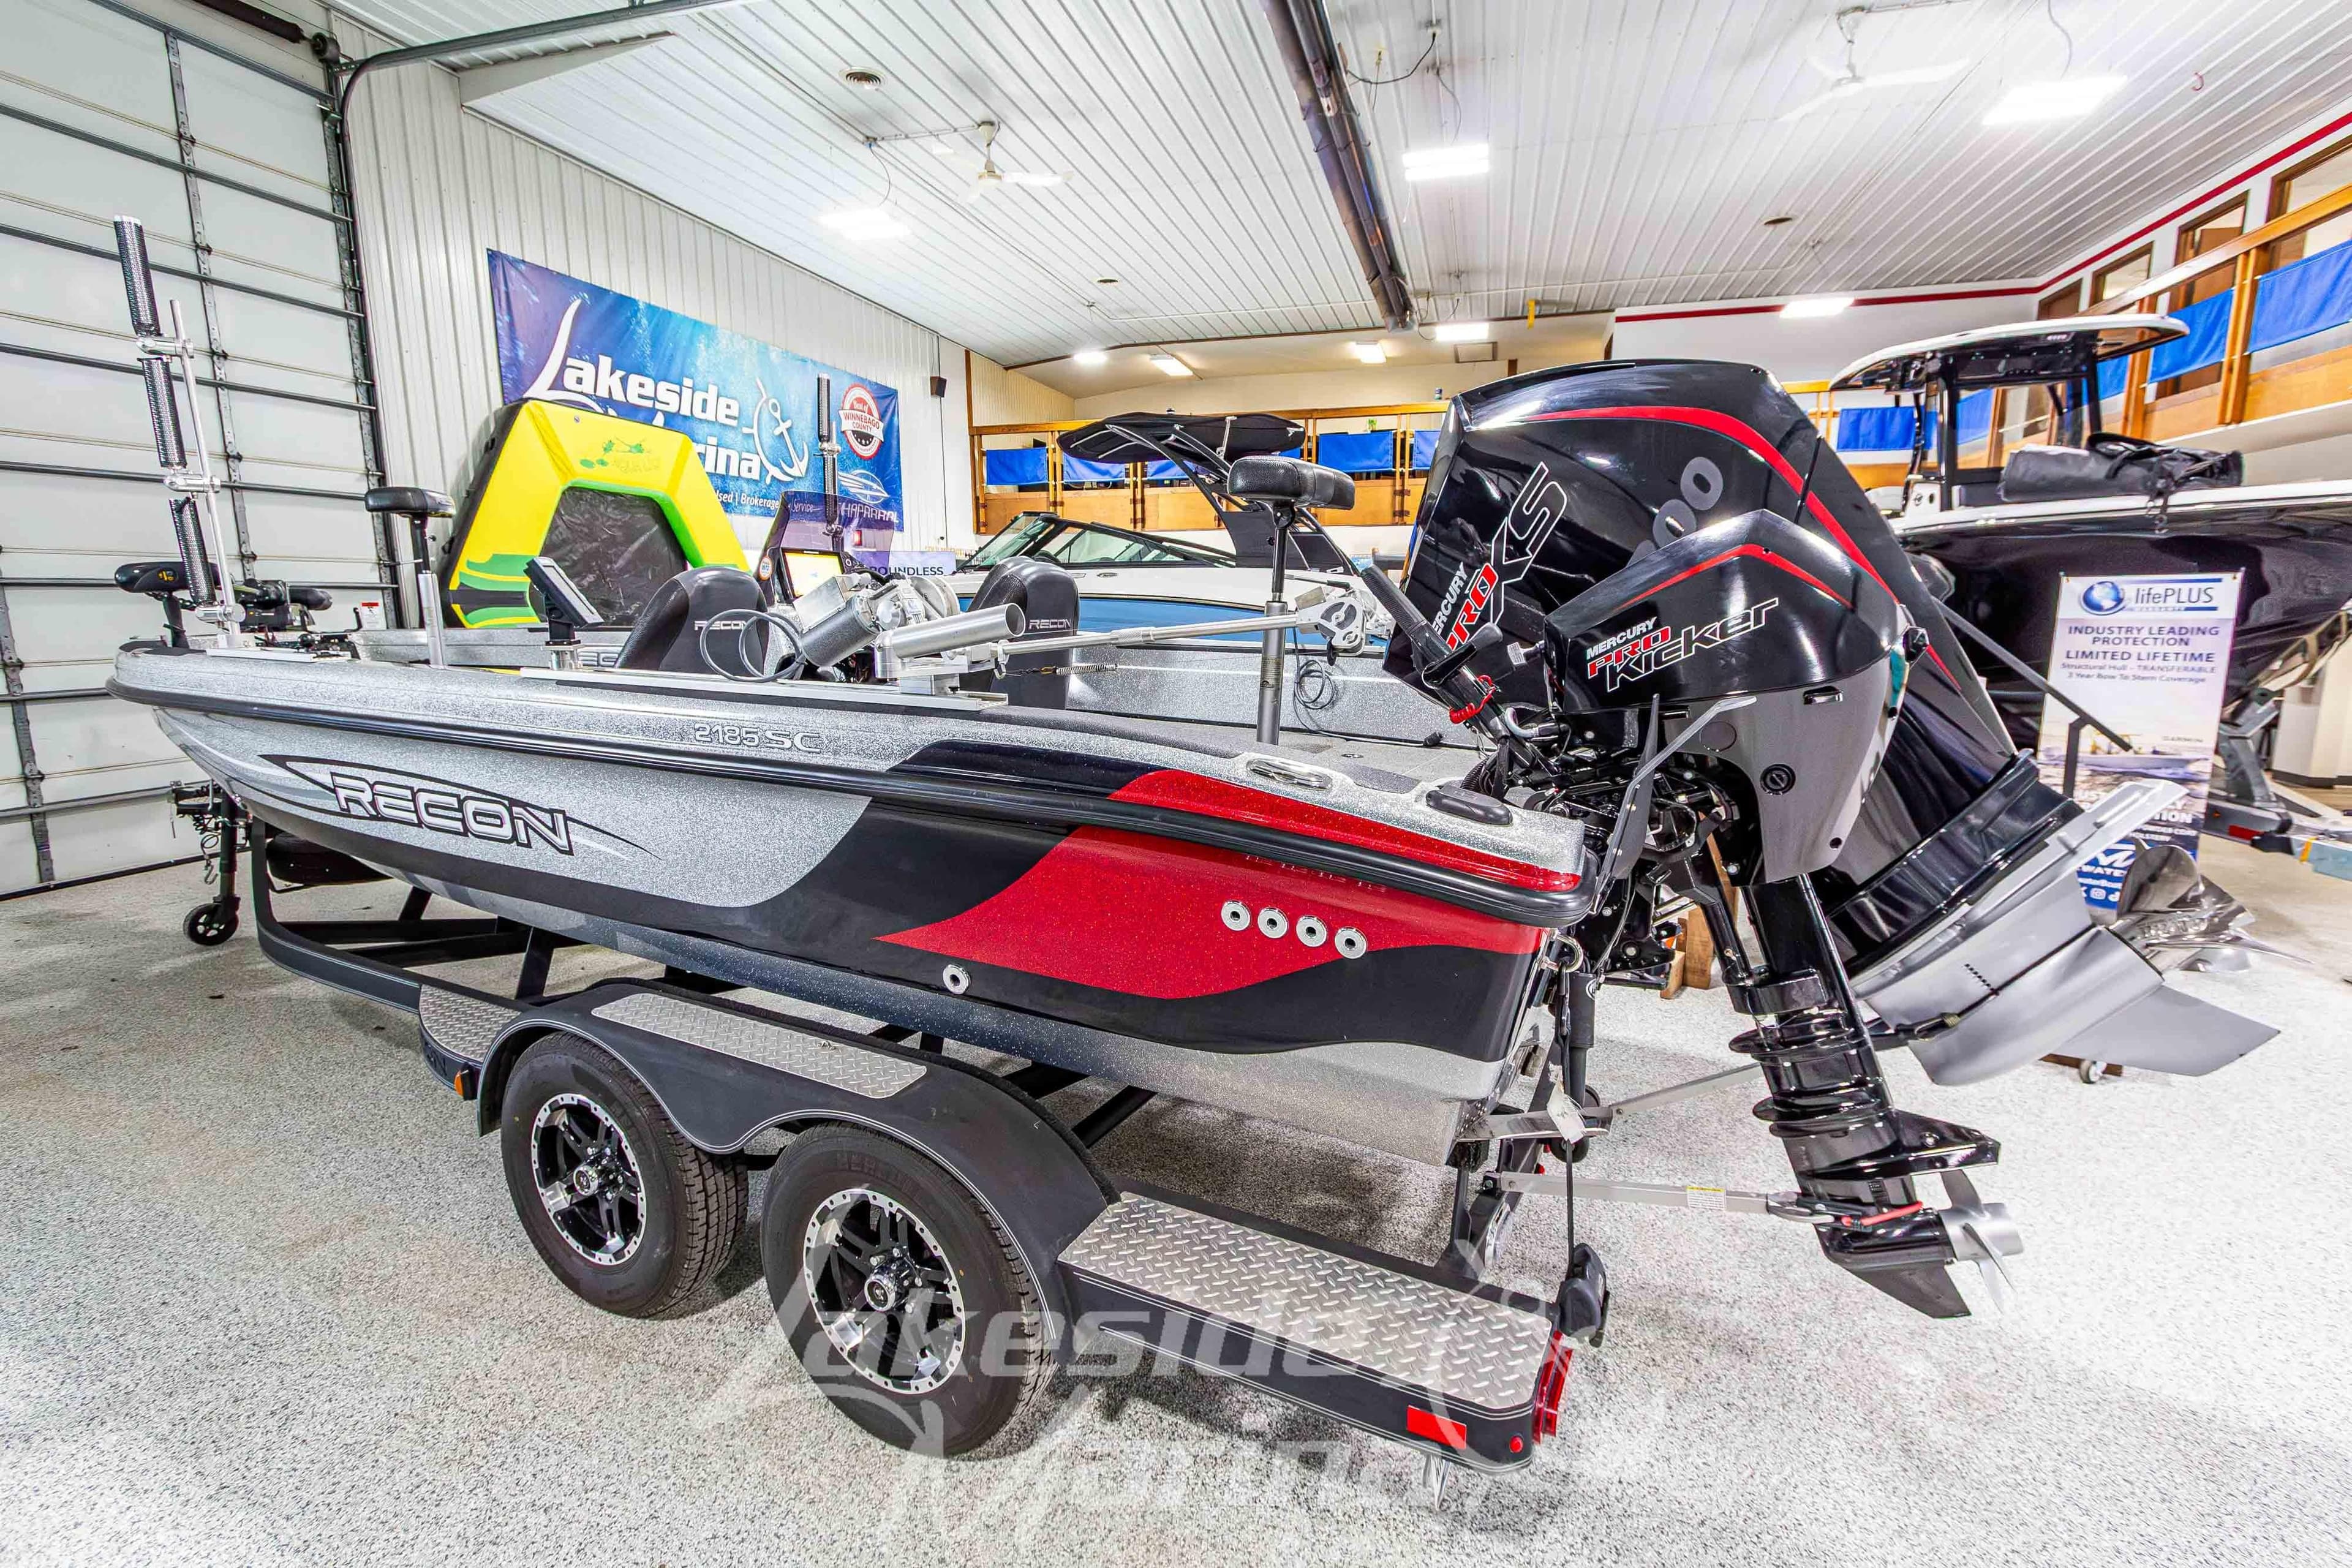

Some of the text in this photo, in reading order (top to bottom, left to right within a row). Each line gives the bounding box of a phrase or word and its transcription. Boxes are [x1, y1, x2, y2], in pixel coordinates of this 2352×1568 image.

[523, 298, 739, 427] Lakeside
[843, 412, 880, 429] WINNEBAGO
[852, 421, 873, 432] COUNTY
[792, 498, 814, 513] Service
[839, 502, 899, 523] HAPARRAL
[1432, 561, 1468, 636] ERCURY
[2135, 587, 2215, 605] lifePLUS
[1029, 618, 1071, 630] RECON
[2068, 625, 2220, 636] INDUSTRY LEADING
[1586, 616, 1657, 660] MERCURY
[2091, 636, 2191, 646] PROTECTION
[1588, 626, 1672, 680] PRO
[2065, 650, 2216, 662] LIMITED LIFETIME
[693, 722, 822, 754] 2185 SC
[330, 771, 575, 857] RECON
